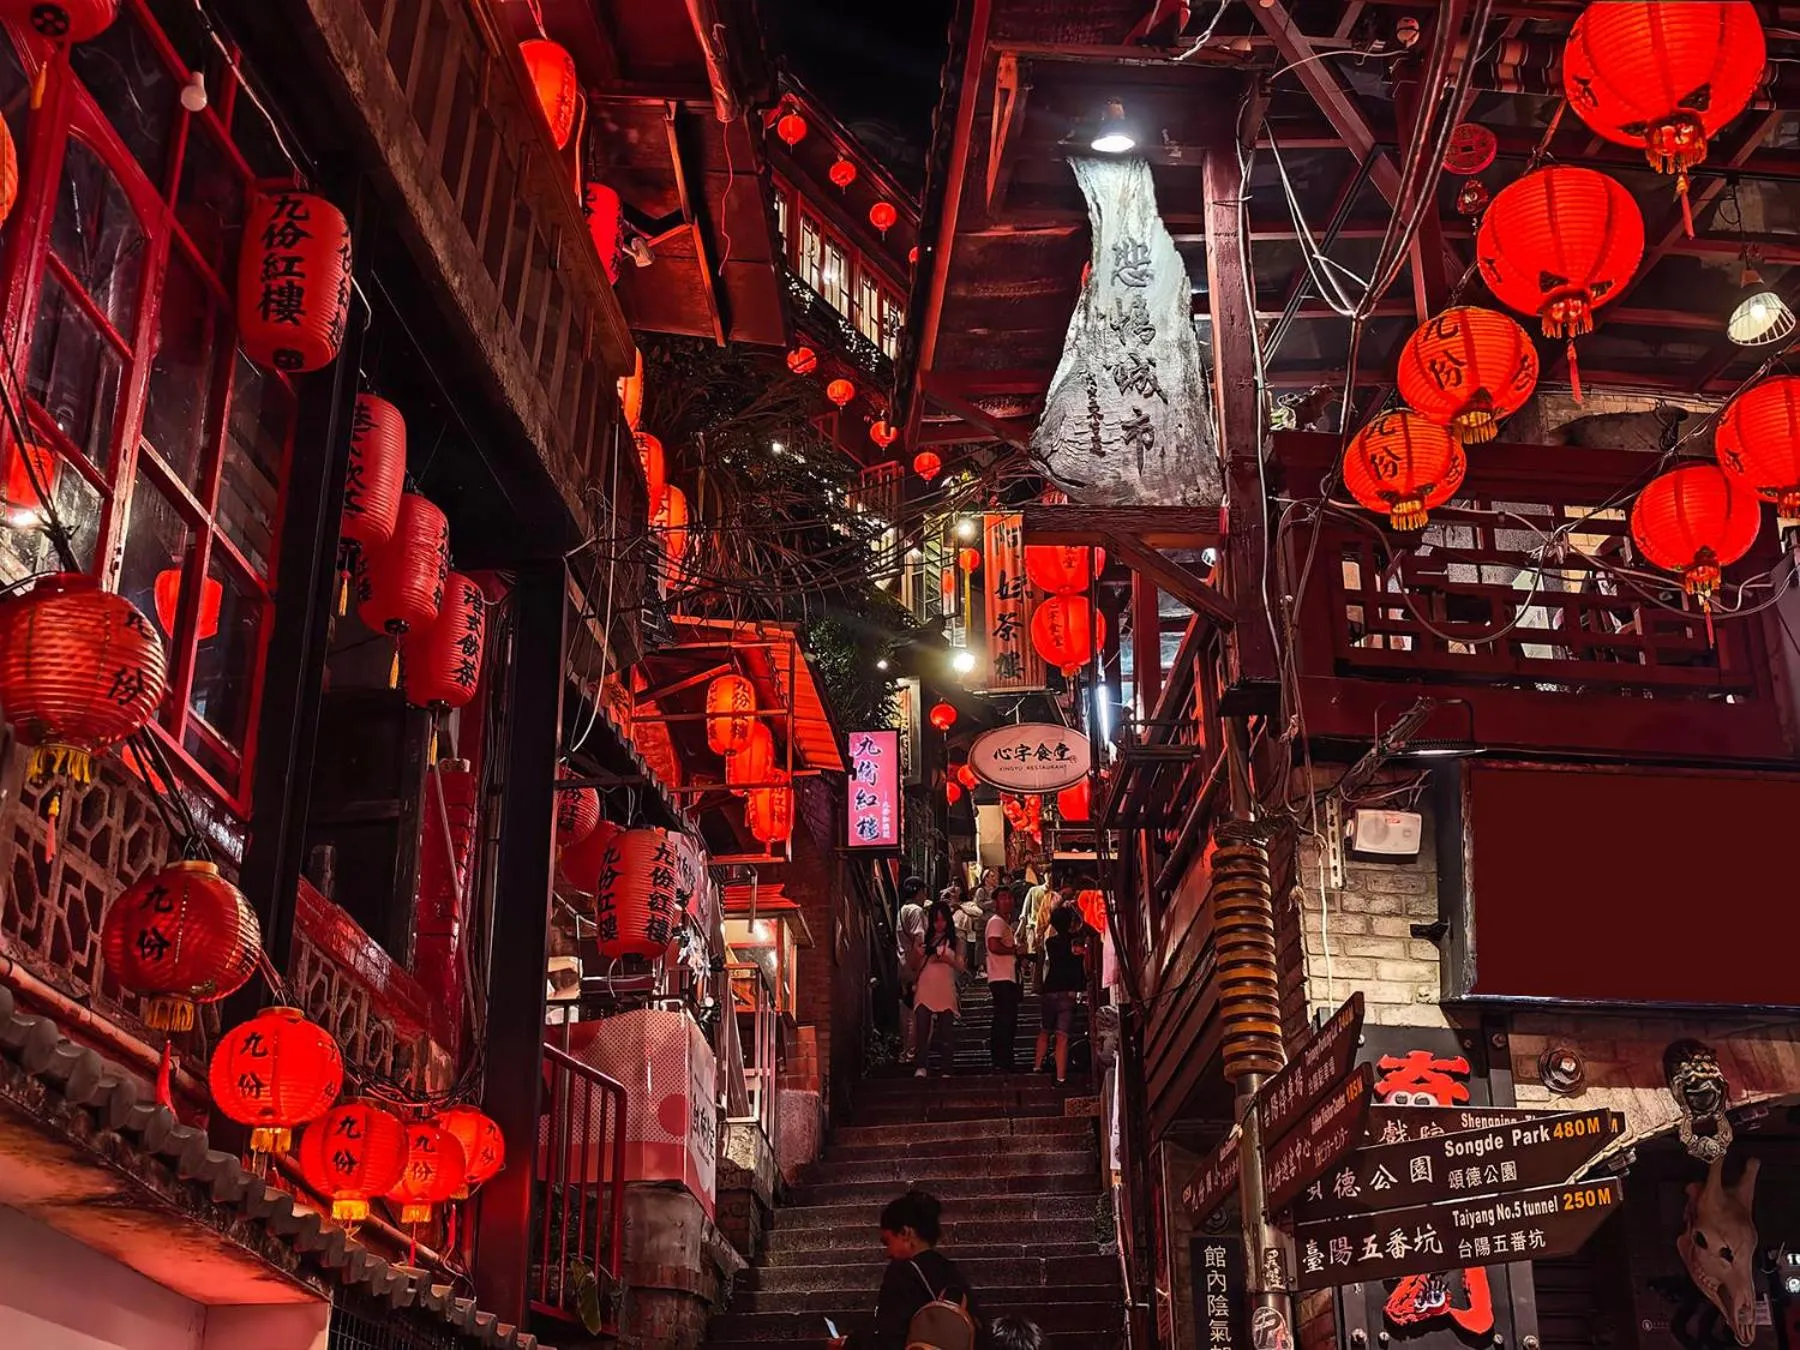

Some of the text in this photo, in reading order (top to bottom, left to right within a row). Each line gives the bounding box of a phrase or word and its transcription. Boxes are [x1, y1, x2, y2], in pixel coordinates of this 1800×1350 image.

[258, 196, 314, 326] 九份紅樓
[1103, 236, 1168, 477] 悲情城市
[1423, 316, 1467, 391] 九份
[1366, 417, 1402, 481] 九份
[107, 611, 160, 706] 九份
[455, 583, 485, 688] 港式飲茶
[993, 742, 1071, 763] 心字食堂
[136, 884, 174, 962] 九份
[597, 847, 625, 941] 九份紅樓
[645, 843, 677, 947] 九份紅樓
[237, 1031, 268, 1100] 九份
[332, 1115, 362, 1176] 九份
[413, 1135, 437, 1182] 九份
[481, 1121, 499, 1166] 九份
[1363, 1119, 1446, 1144] 戲院
[1444, 1133, 1504, 1158] Songde
[1512, 1124, 1551, 1147] Park
[1447, 1160, 1518, 1190] 頌德公園
[1452, 1209, 1495, 1229] Taiyang
[1496, 1200, 1523, 1221] No.5
[1523, 1194, 1560, 1217] tunnel
[1458, 1228, 1547, 1259] 台陽五番坑
[1302, 1223, 1445, 1275] 臺陽五番坑
[1203, 1245, 1232, 1350] 館內陰氣
